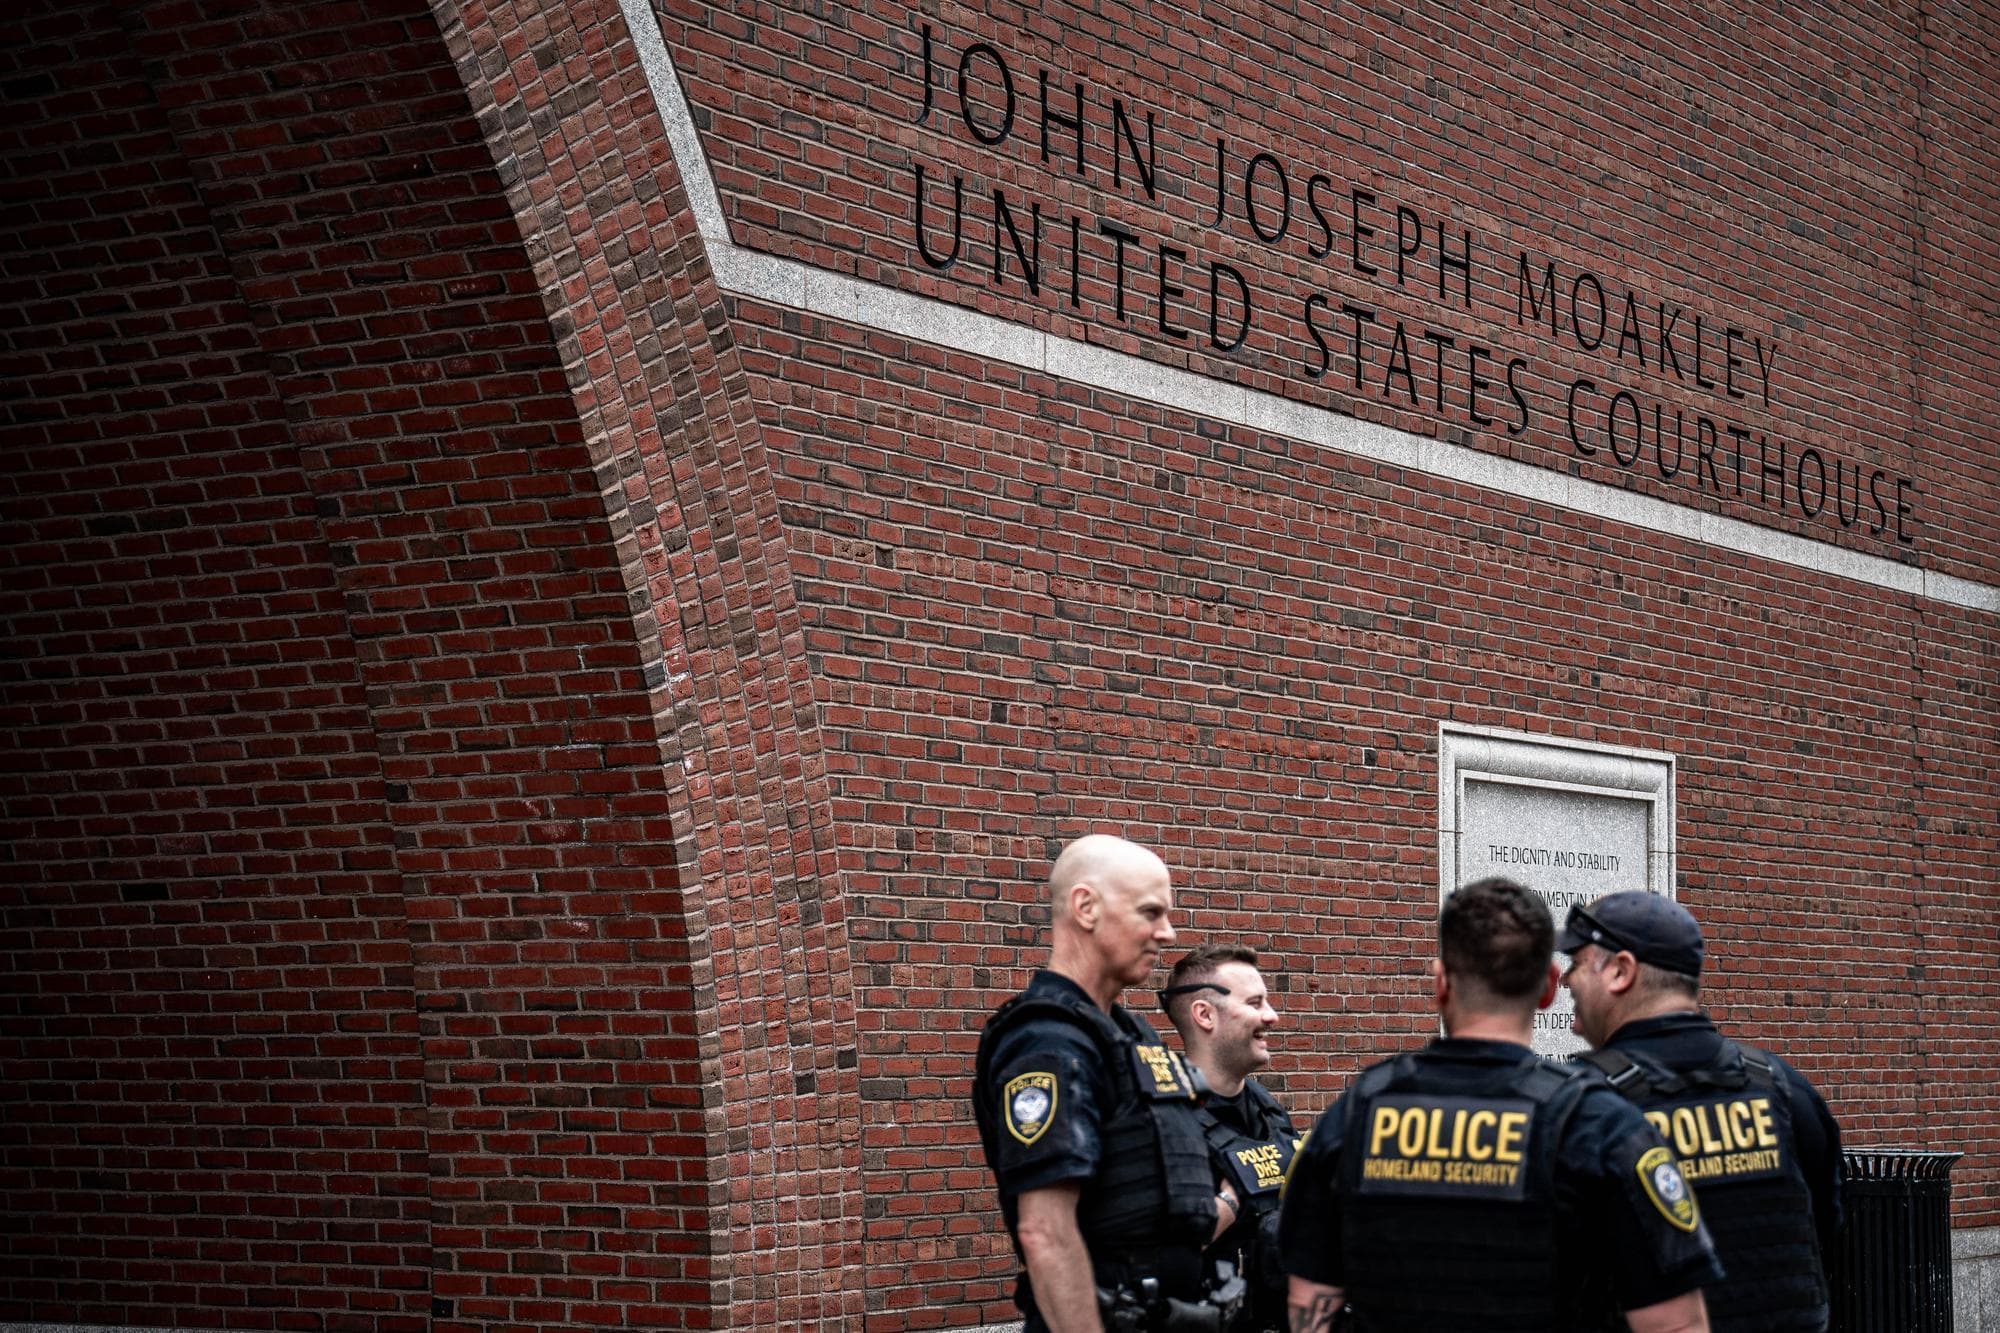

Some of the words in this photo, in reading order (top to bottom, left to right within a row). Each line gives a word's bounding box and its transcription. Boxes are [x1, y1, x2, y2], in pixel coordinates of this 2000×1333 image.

[915, 23, 1155, 200] JOHN
[1208, 138, 1472, 308] JOSEPH
[1517, 252, 1778, 407] MOAKLEY
[915, 164, 1252, 353] UNITED
[1304, 294, 1529, 436] STATES
[1568, 379, 1912, 544] COURTHOUSE
[1489, 845, 1509, 863] THE
[1511, 847, 1552, 867] DIGNITY
[1553, 851, 1576, 868] AND
[1577, 853, 1621, 871] STABILITY
[1528, 889, 1574, 908] NMENT
[1010, 1076, 1051, 1095] POLICE
[1370, 1106, 1528, 1162] POLICE
[1236, 1144, 1283, 1167] POLICE
[1725, 1149, 1781, 1174] SECURITY
[1253, 1160, 1281, 1179] DHS
[1363, 1157, 1443, 1182] HOMELAND
[1444, 1161, 1520, 1187] SECURITY
